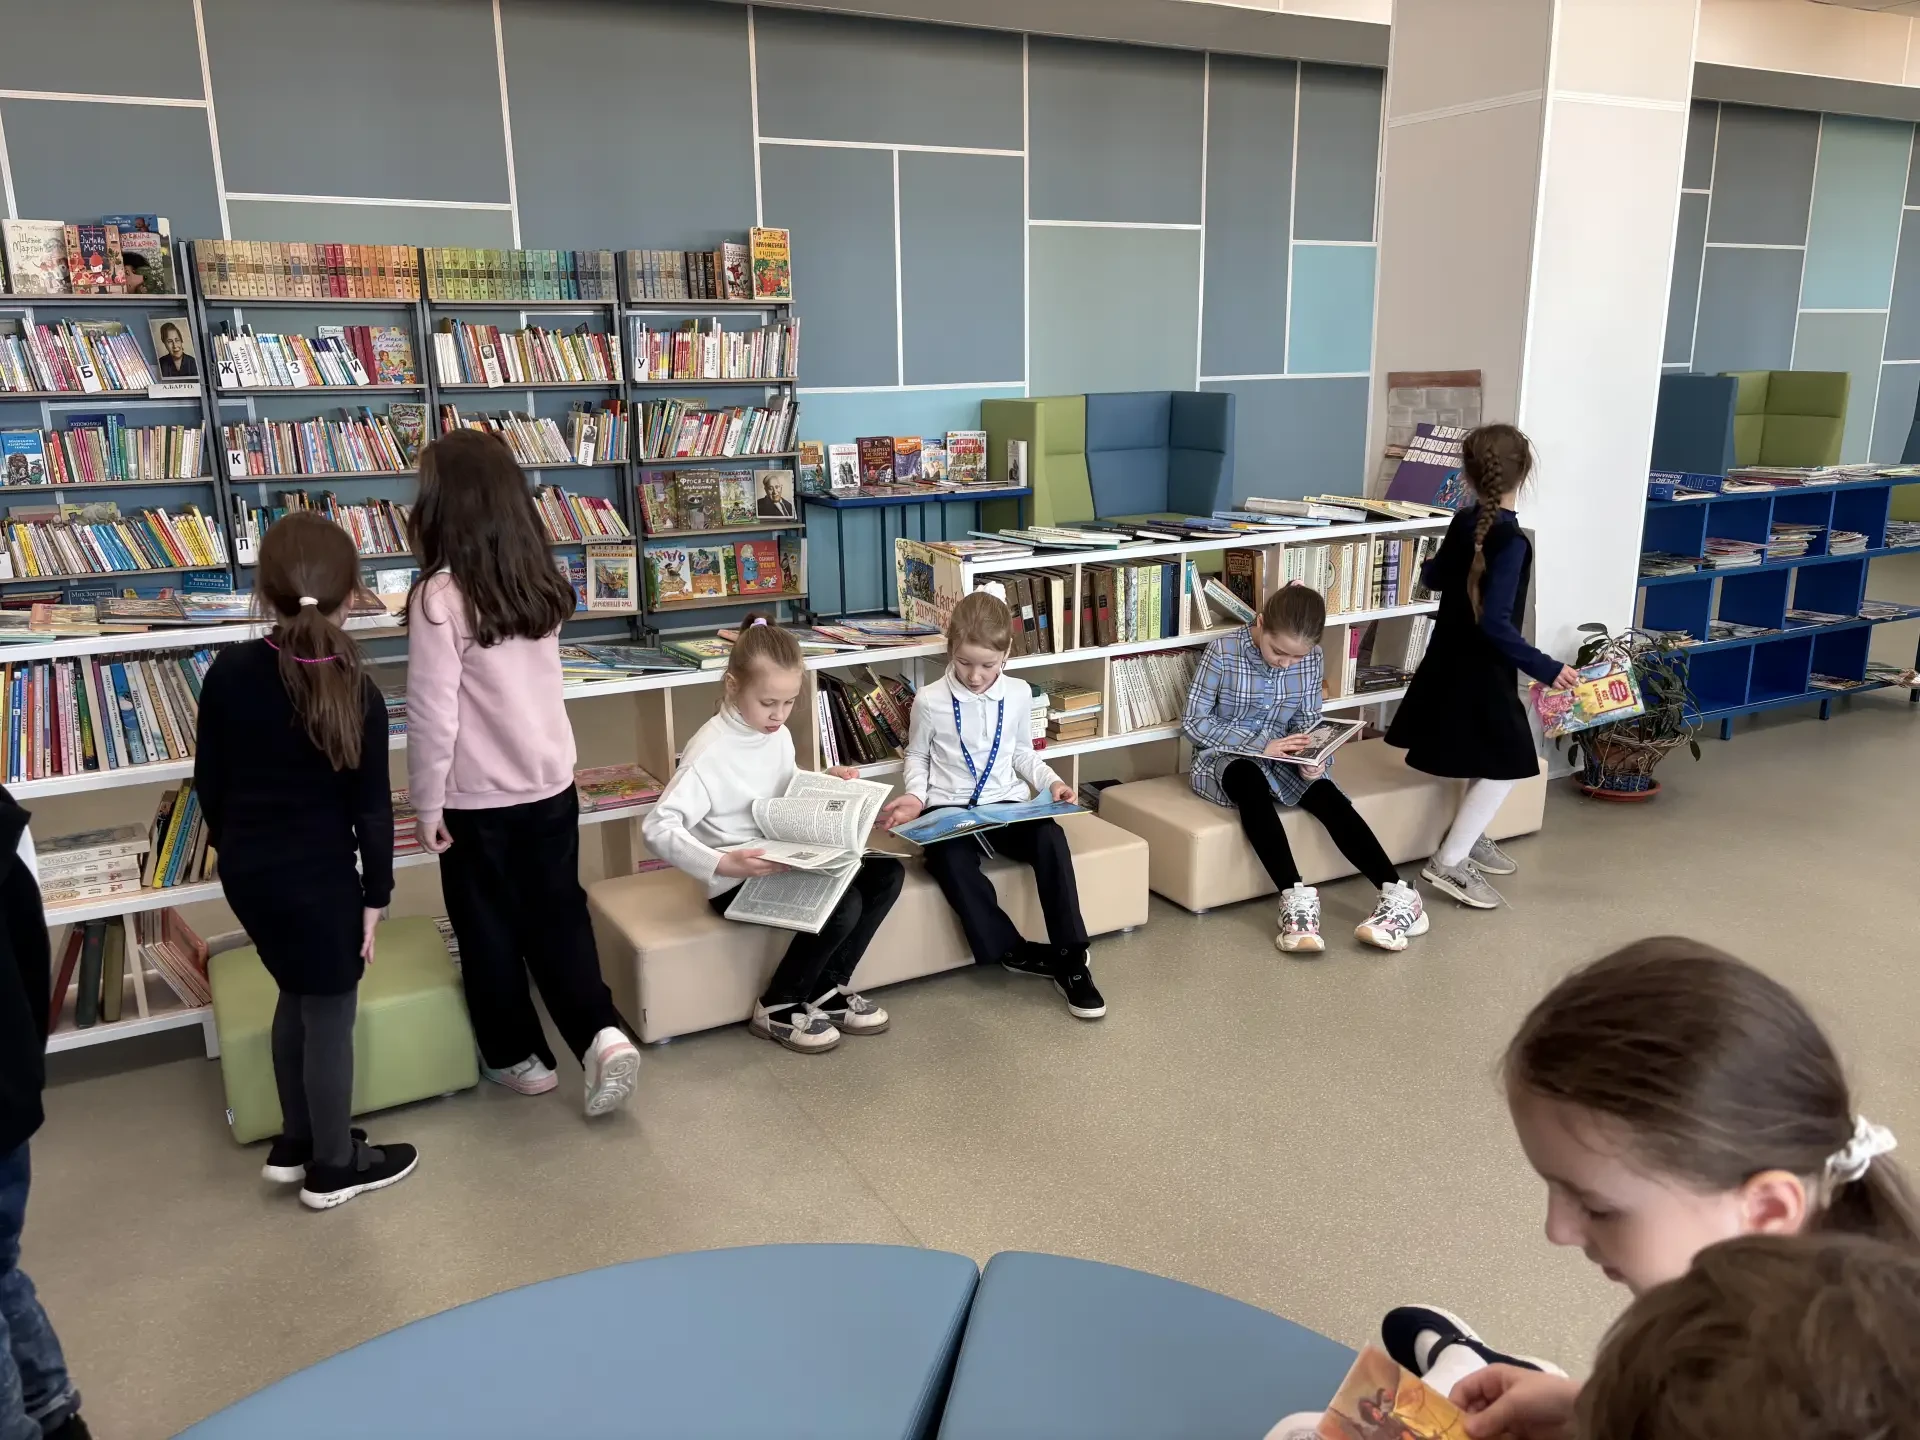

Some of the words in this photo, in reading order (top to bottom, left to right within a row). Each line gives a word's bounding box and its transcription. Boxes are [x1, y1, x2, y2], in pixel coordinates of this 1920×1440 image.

[221, 361, 234, 375] Ж
[234, 352, 244, 374] БОРИС
[290, 363, 300, 374] З
[351, 360, 361, 371] И
[80, 366, 93, 378] Б
[232, 453, 241, 465] К
[239, 539, 249, 550] Л
